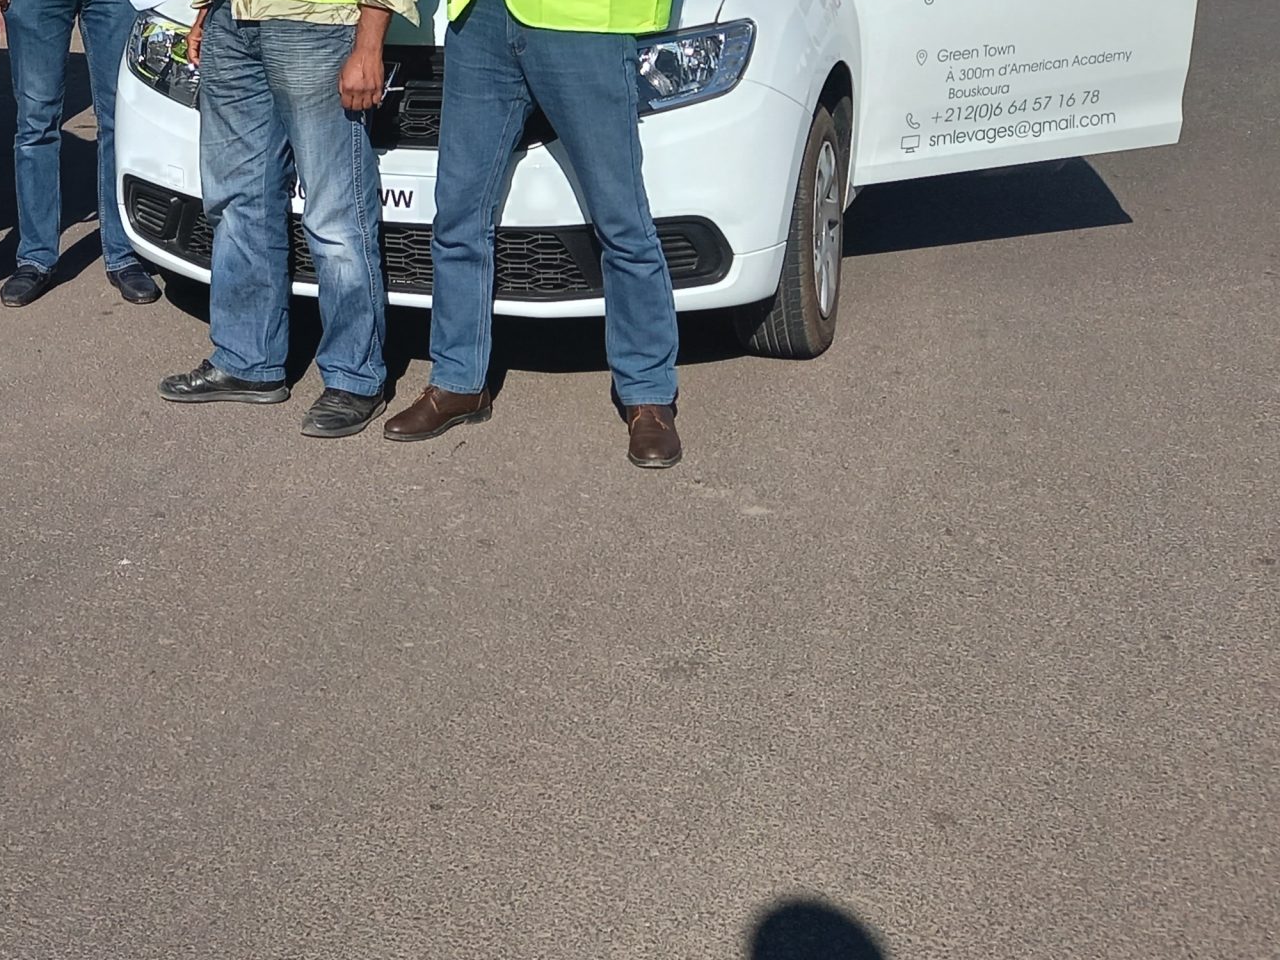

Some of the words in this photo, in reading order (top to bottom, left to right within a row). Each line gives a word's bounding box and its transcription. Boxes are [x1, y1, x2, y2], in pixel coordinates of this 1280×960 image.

[937, 47, 980, 64] Green
[983, 43, 1016, 60] Town
[945, 66, 955, 83] À
[958, 65, 995, 82] 300m
[998, 56, 1069, 77] d'American
[1072, 48, 1133, 68] Academy
[931, 100, 1003, 123] +212(0)6
[1008, 98, 1027, 114] 64
[1032, 95, 1052, 111] 57
[1059, 91, 1076, 108] 16
[1082, 89, 1100, 106] 78
[948, 83, 1010, 100] Bouskoura
[928, 109, 1116, 148] smlevages@gmail.com
